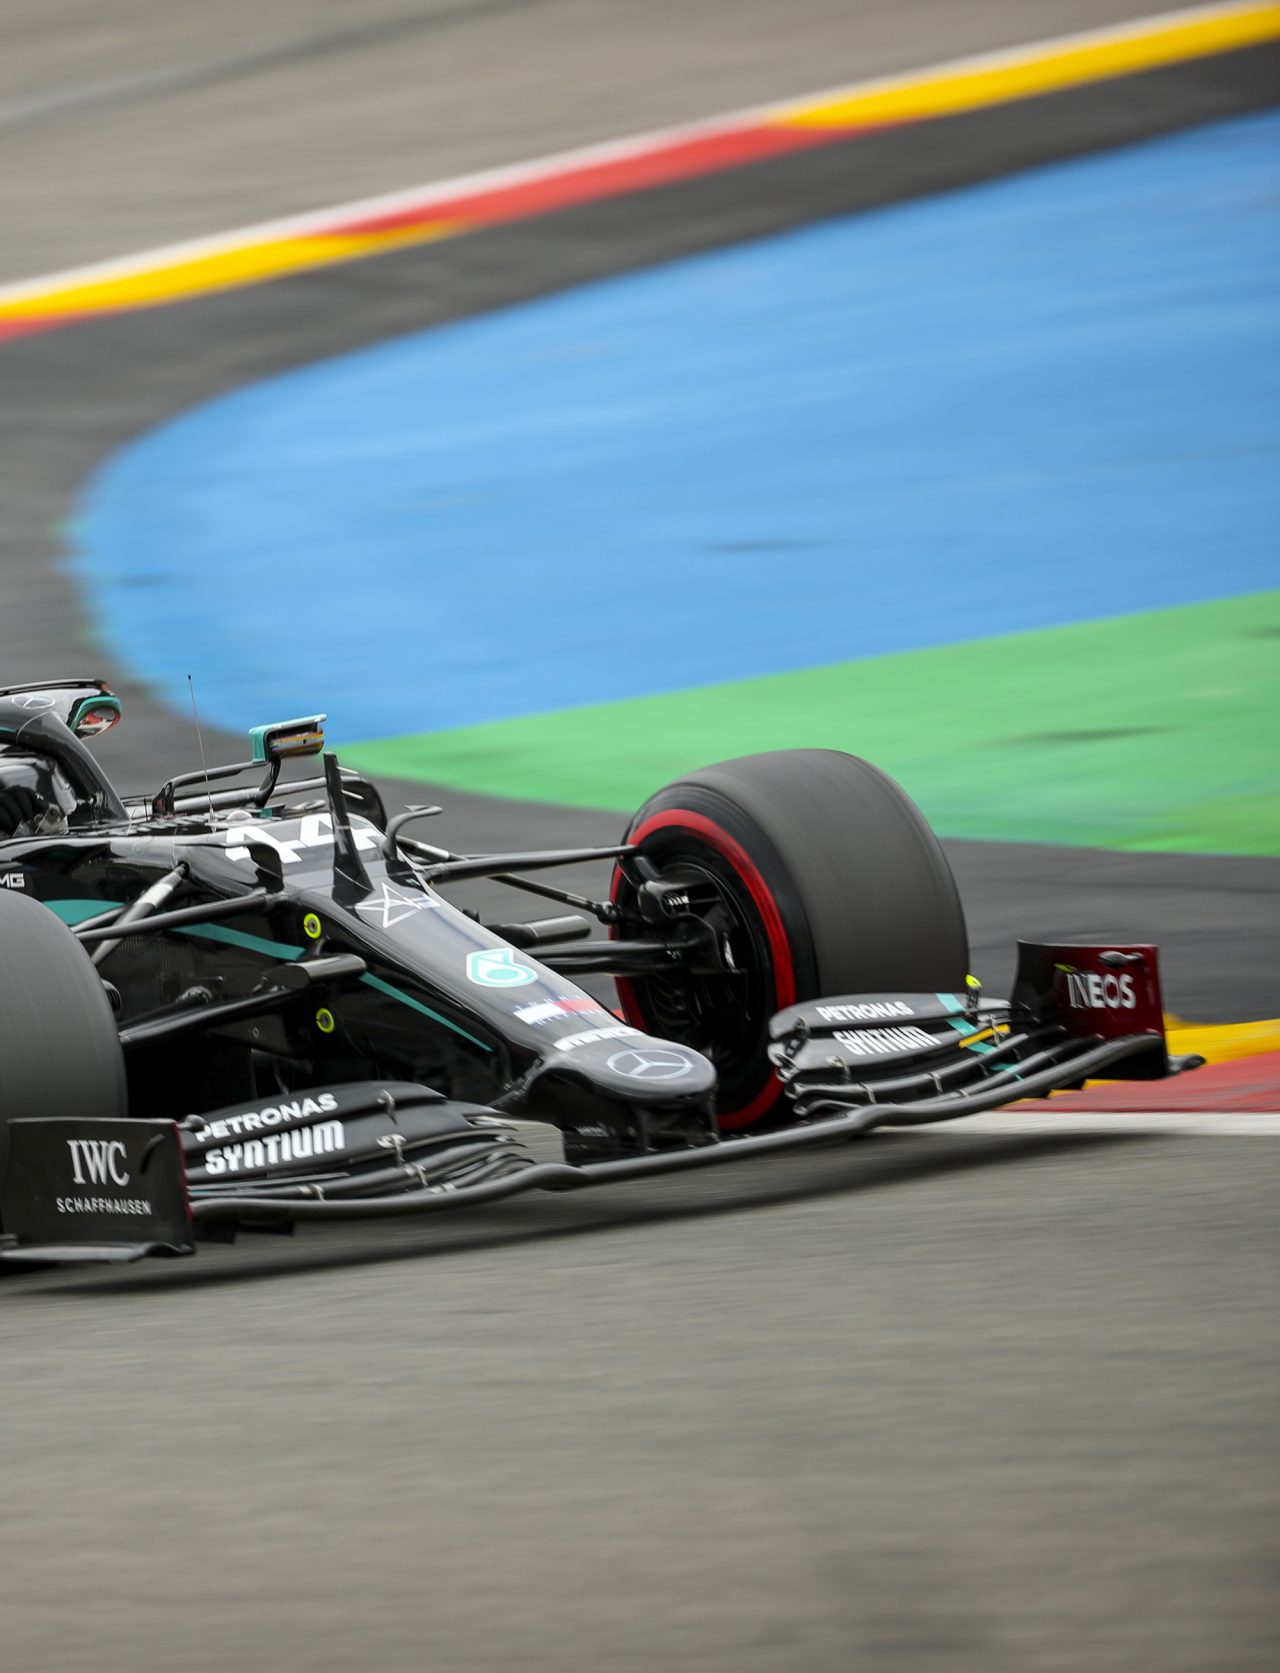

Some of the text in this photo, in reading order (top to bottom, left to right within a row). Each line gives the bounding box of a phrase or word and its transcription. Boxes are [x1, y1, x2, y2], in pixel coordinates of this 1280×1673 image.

[815, 1001, 915, 1022] PETRONAS
[1066, 973, 1137, 1009] INEOS
[195, 1093, 338, 1142] PETRONAS
[67, 1139, 130, 1187] IWC
[205, 1120, 345, 1175] SYNTIUM
[56, 1197, 152, 1215] SCHAFFHAUSEN
